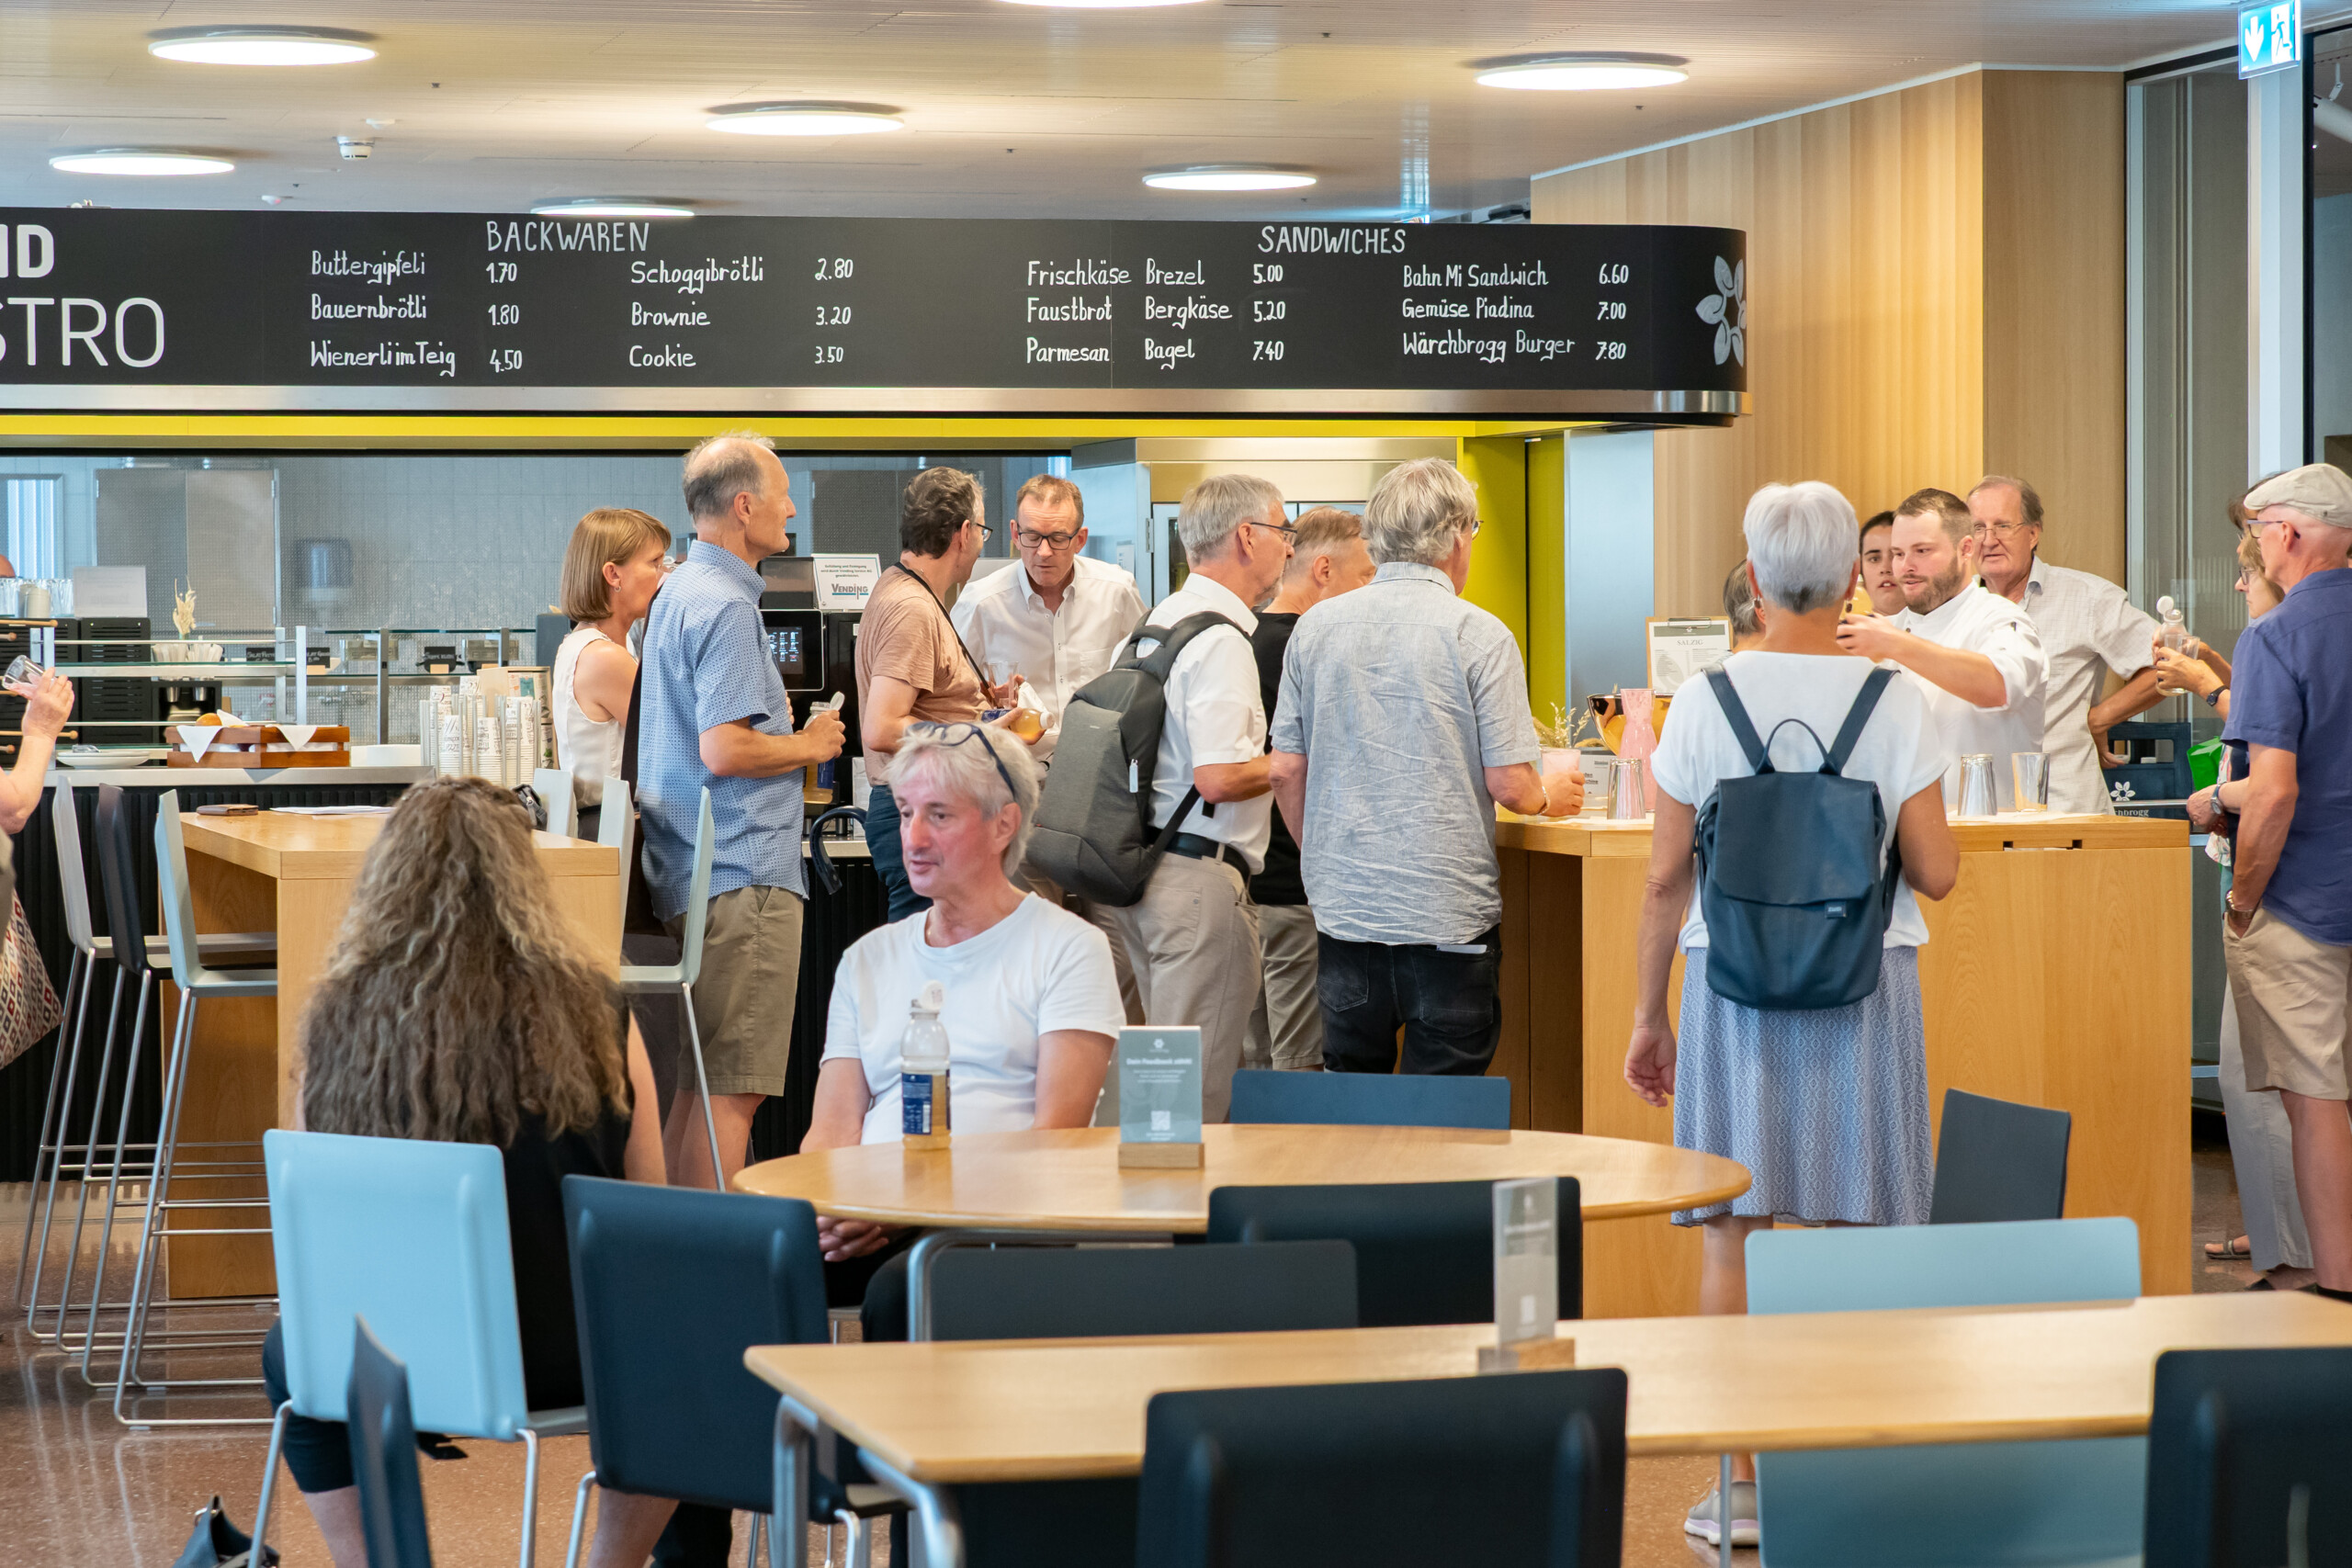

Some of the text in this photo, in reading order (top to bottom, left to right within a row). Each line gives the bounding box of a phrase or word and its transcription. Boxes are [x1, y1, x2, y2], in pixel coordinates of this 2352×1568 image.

[486, 220, 650, 252] BACKWAREN
[1257, 226, 1407, 254] SANDWICHES
[311, 250, 518, 285] Buttergipfeli 1.70
[630, 256, 854, 294] Schoggibrötli 2.80
[1027, 258, 1284, 287] Frischkäse Brezel 5.00
[1403, 260, 1630, 288] Bahn Mi Sandwich 6.60
[311, 293, 520, 326] Bauernbrötli 1.80
[631, 300, 852, 326] Brownie 3.20
[1027, 294, 1286, 329] Faustbrot Bergkäse 5.20
[1402, 295, 1627, 321] Gemüse Piadina 7.00
[490, 349, 523, 373] 4.50
[629, 343, 843, 367] Cookie 3.50
[1026, 337, 1284, 369] Parmesan Bagel 7.40
[1402, 329, 1627, 364] Wärchbrogg Burger 7.80
